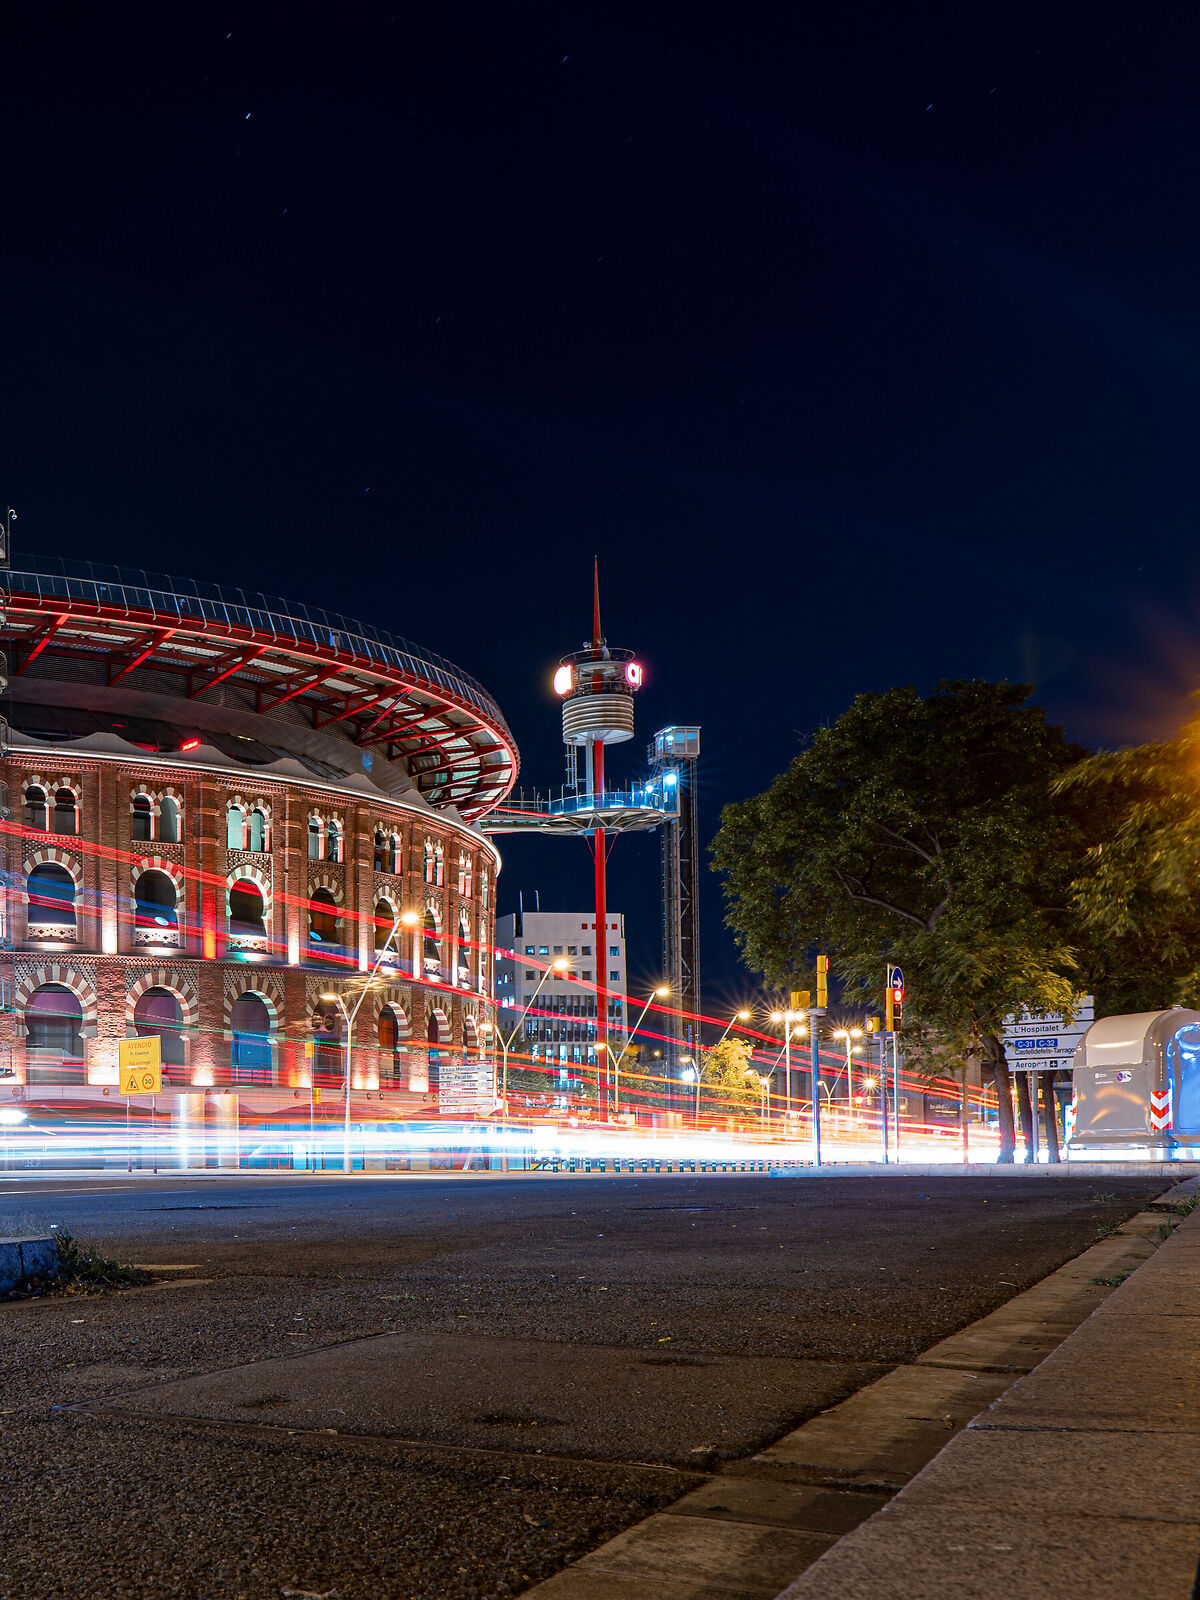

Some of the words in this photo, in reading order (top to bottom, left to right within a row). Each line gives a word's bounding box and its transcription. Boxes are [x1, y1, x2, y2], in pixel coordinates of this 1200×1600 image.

[1014, 1025, 1059, 1034] L'Hospitalet
[1039, 1039, 1055, 1047] C-32
[1014, 1047, 1076, 1056] Castelldefels-Tarrago
